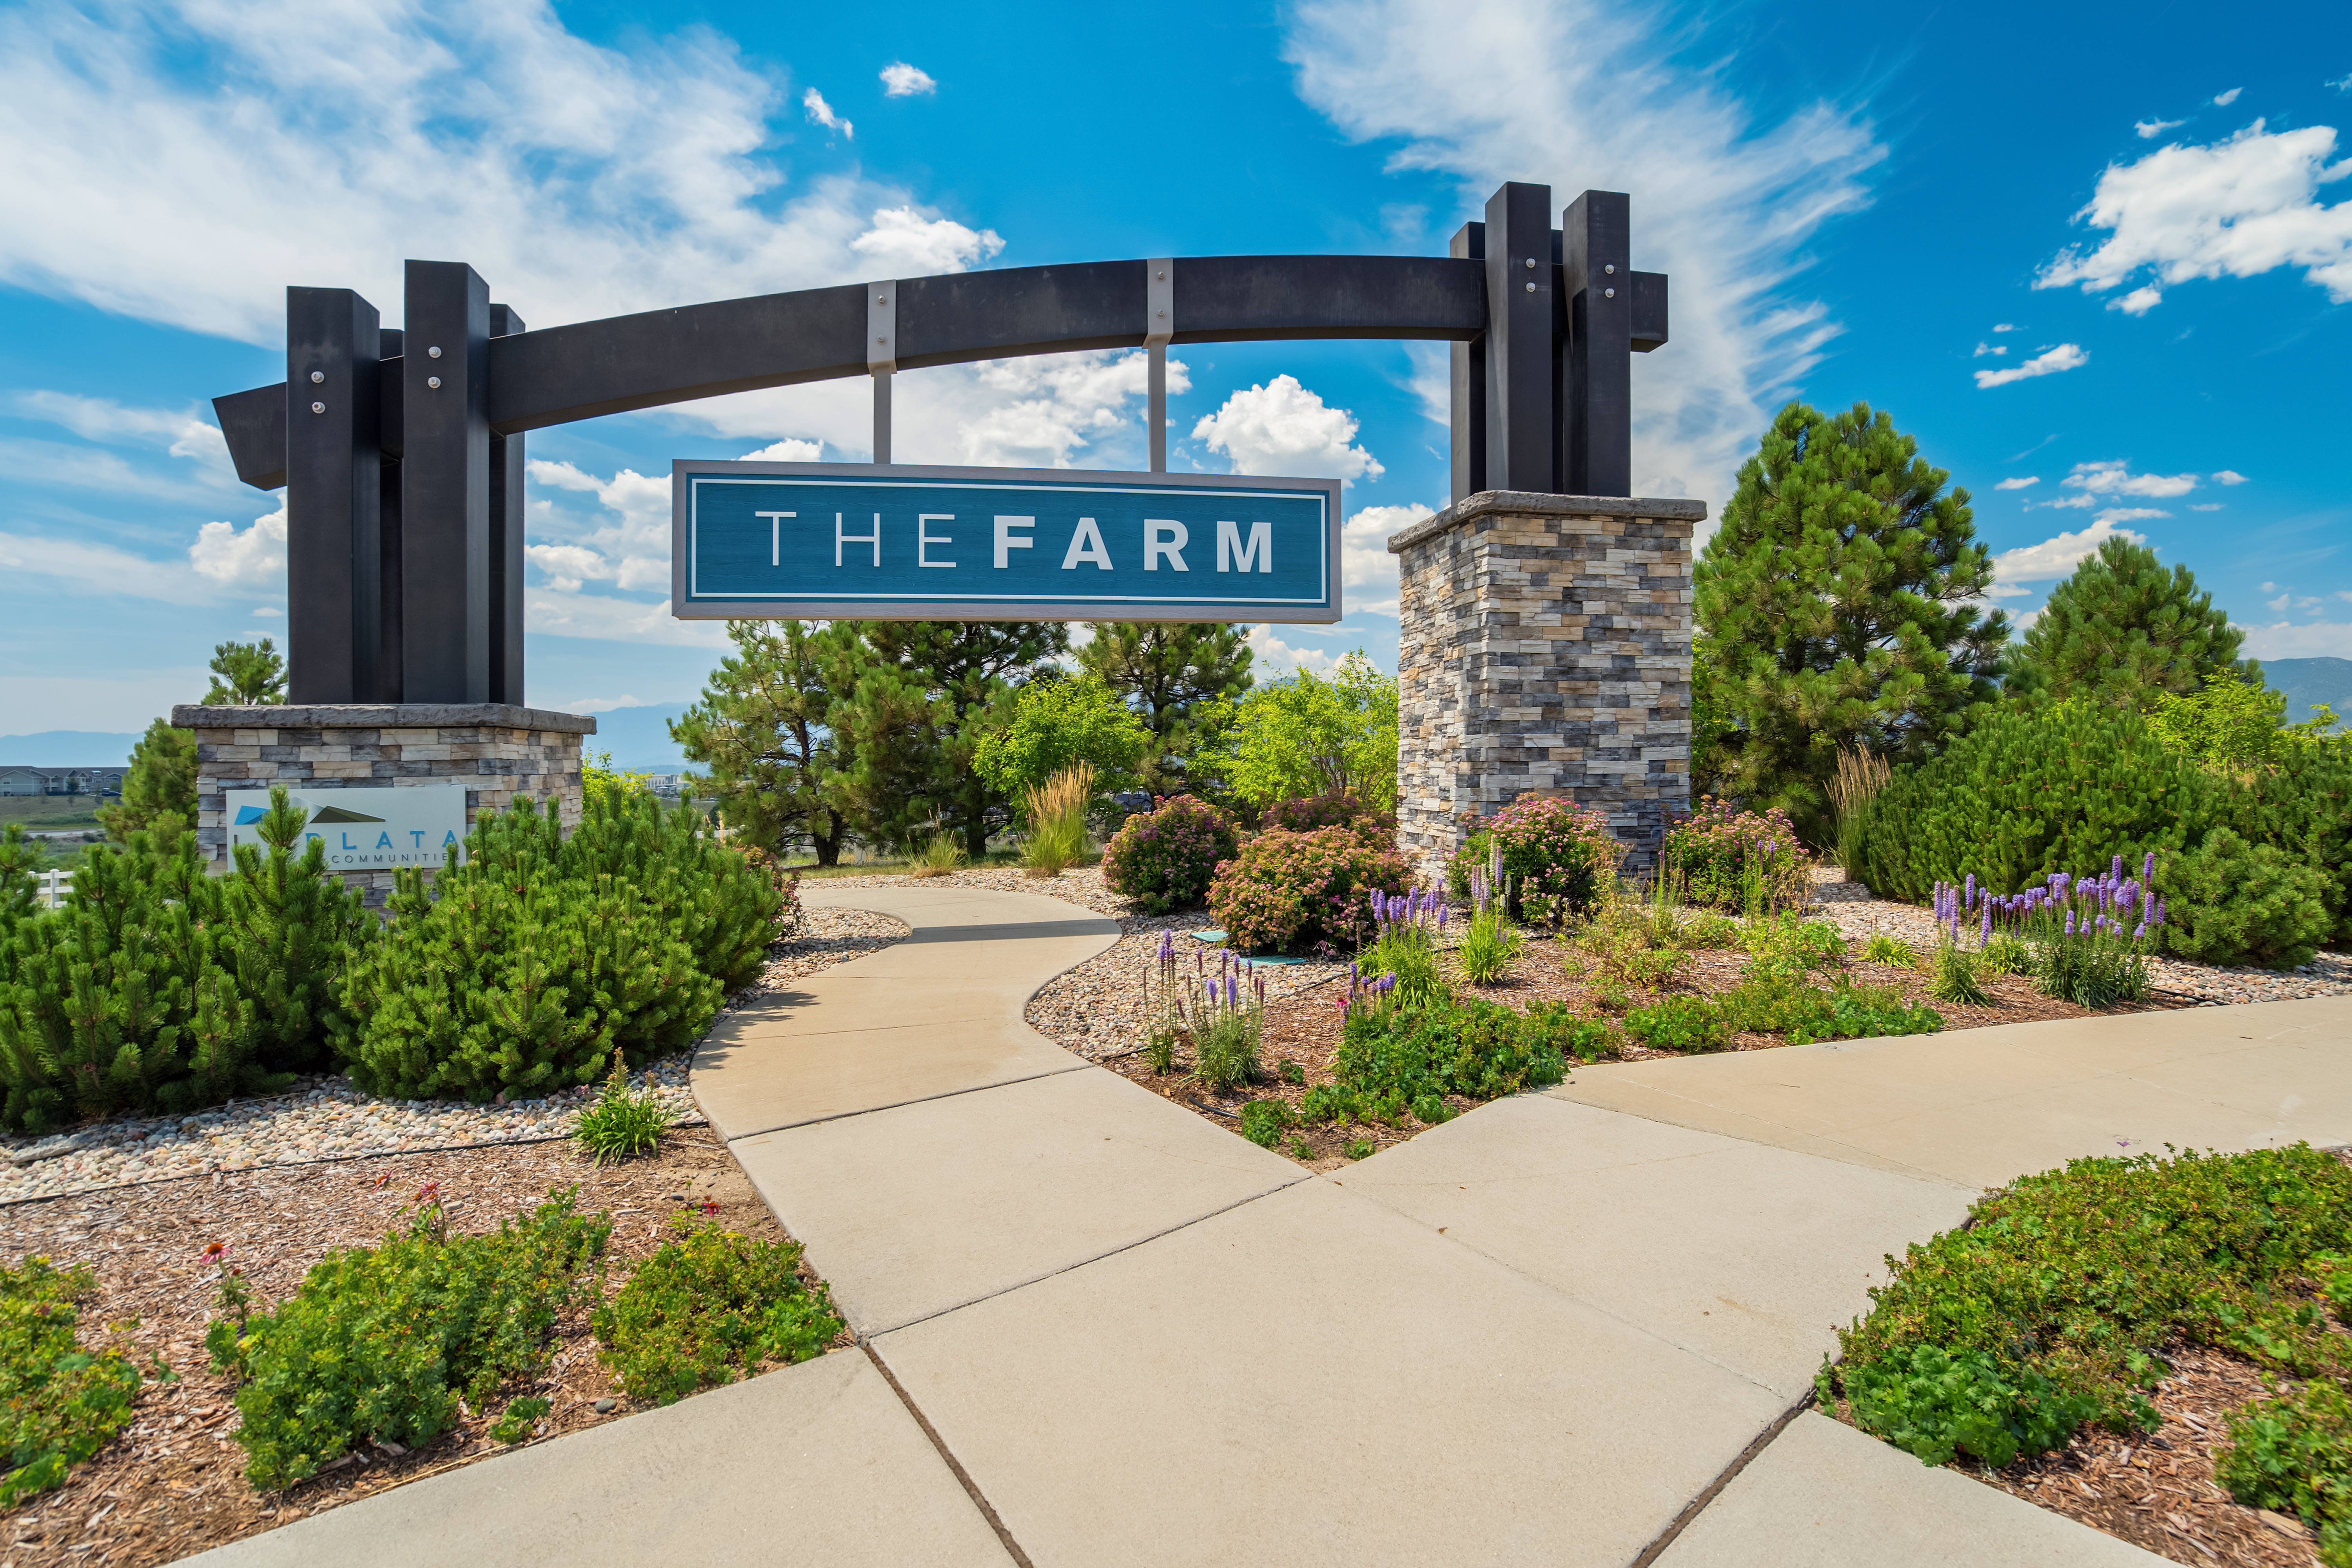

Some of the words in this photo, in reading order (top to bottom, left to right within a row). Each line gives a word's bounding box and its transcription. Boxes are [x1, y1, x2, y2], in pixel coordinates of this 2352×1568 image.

[755, 511, 956, 568] THE
[994, 515, 1272, 573] FARM
[331, 853, 459, 863] COMMUNITIE
